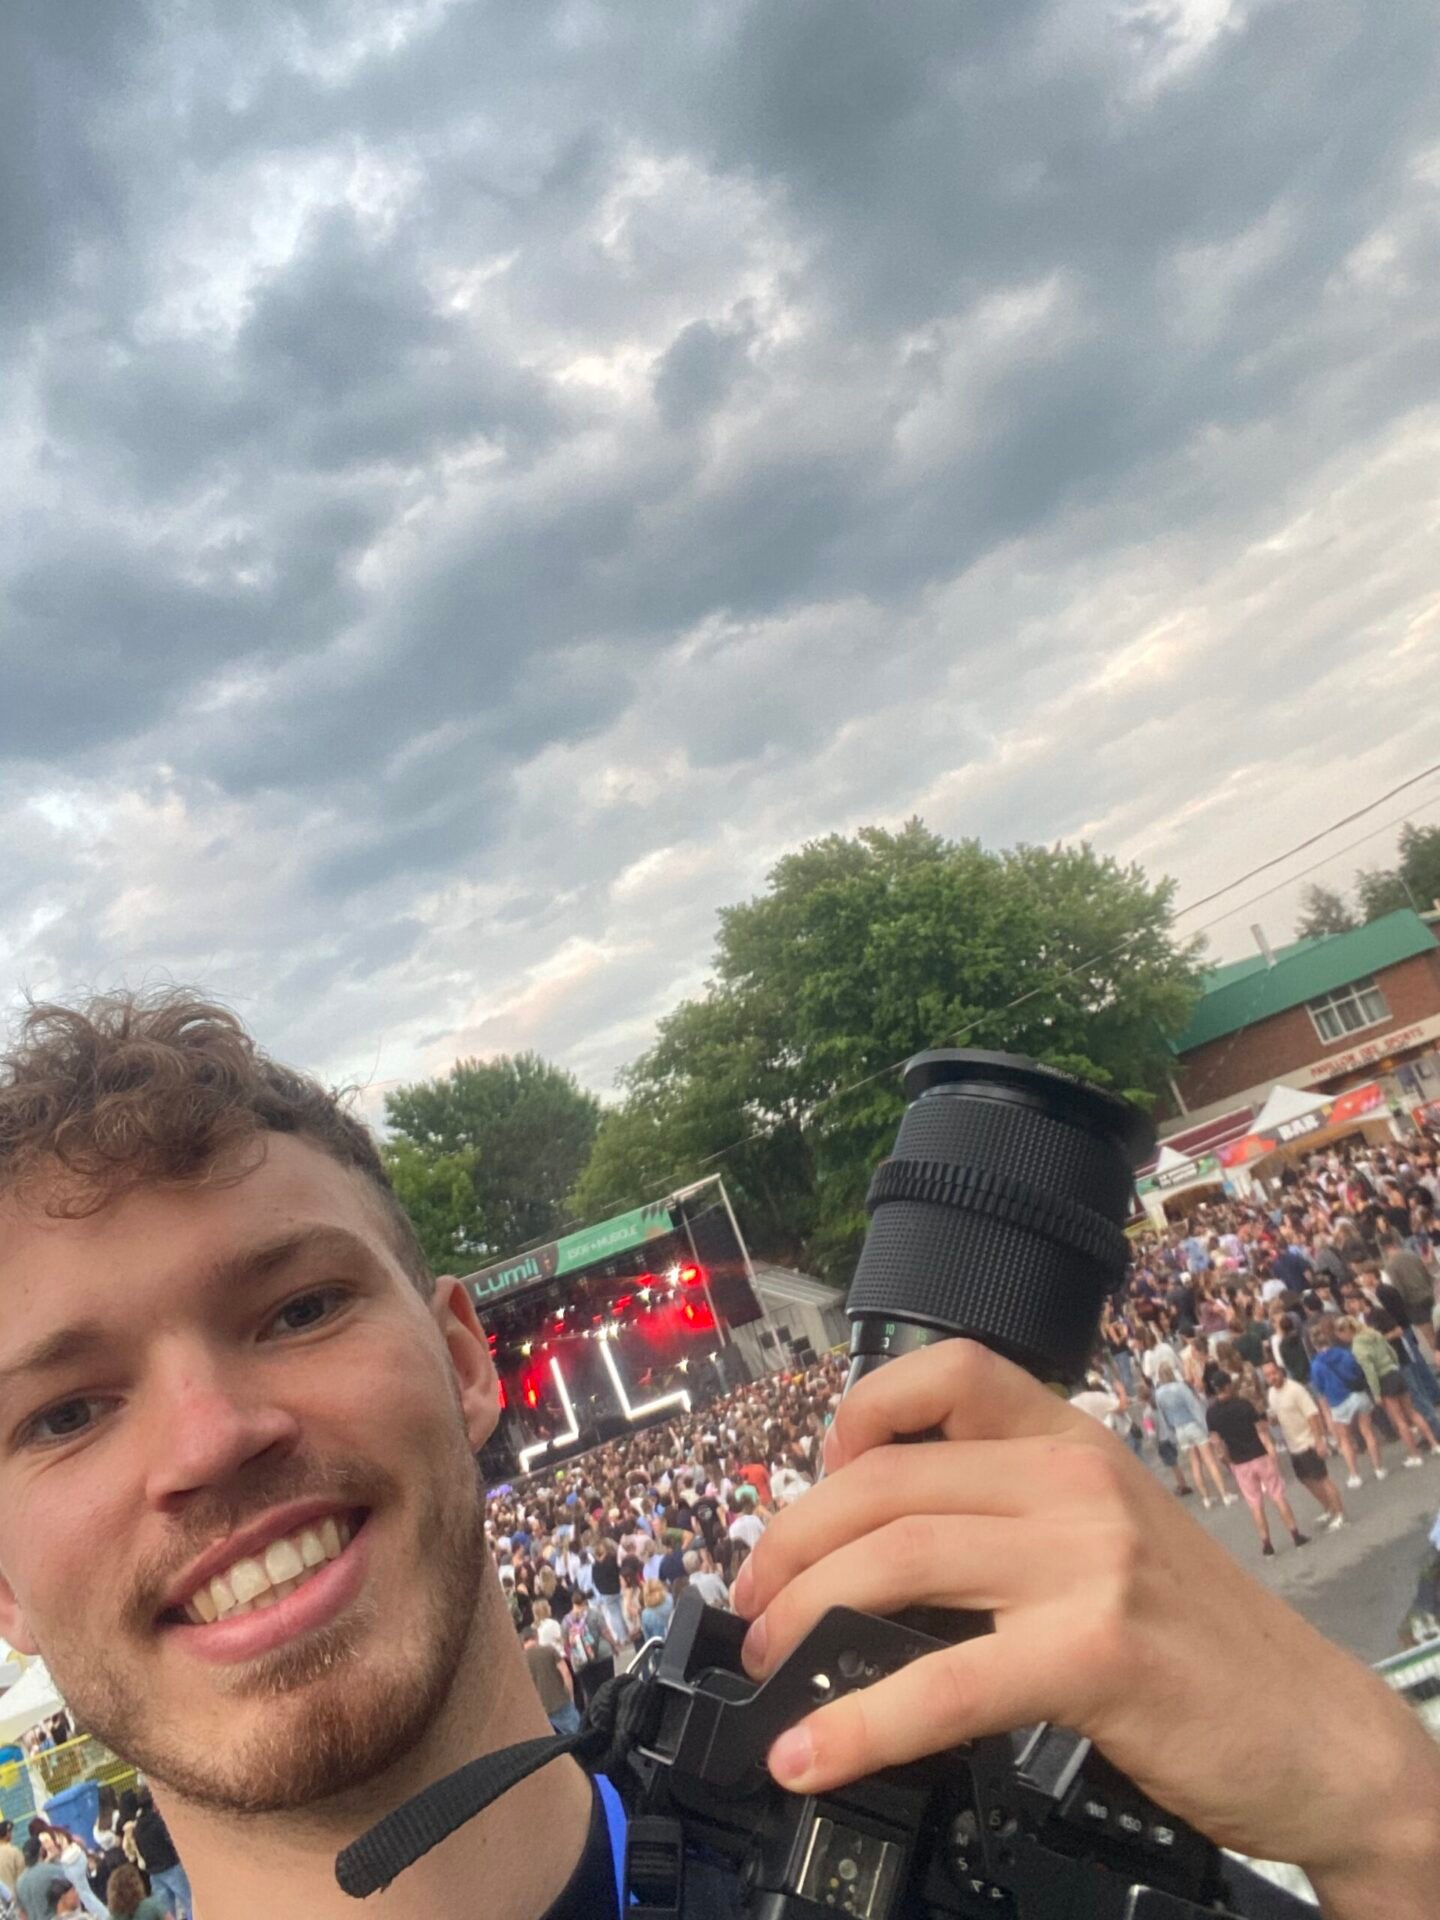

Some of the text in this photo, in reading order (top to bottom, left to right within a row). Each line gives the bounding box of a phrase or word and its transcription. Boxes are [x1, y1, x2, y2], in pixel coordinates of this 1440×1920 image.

[1277, 1114, 1320, 1141] BAR
[884, 1323, 896, 1336] 10
[958, 1857, 969, 1871] S
